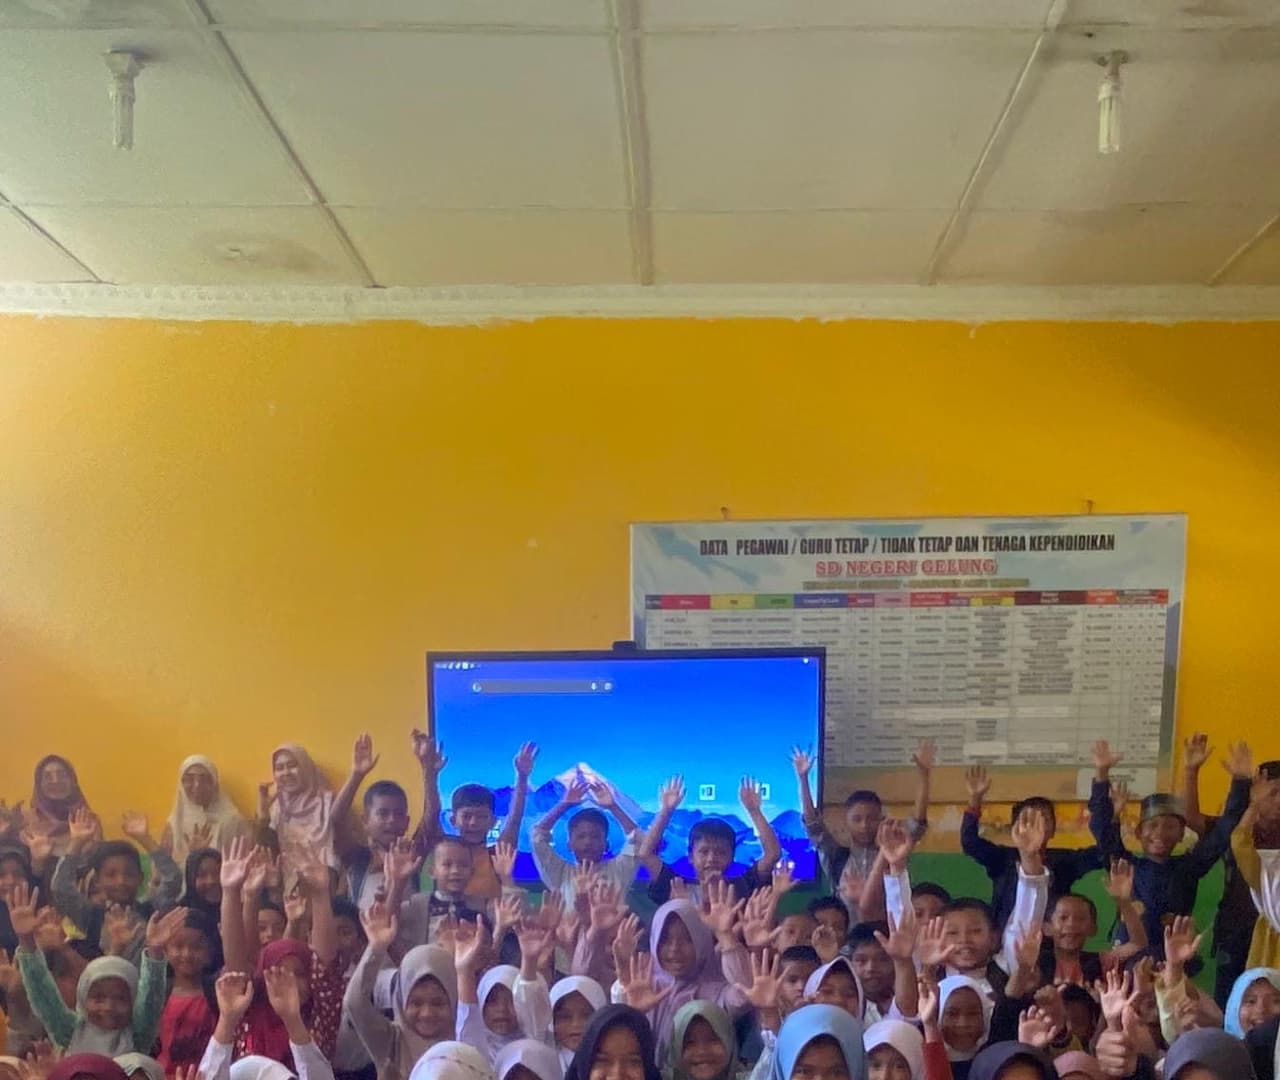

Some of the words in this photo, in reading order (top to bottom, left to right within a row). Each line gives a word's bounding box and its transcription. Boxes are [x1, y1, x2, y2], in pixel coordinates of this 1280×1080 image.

[700, 539, 728, 556] DATA
[736, 538, 789, 556] PEGAWAI
[800, 537, 832, 555] GURU
[834, 537, 869, 554] TETAP
[880, 536, 915, 554] TIDAK
[918, 535, 952, 553] TETAP
[955, 535, 979, 552] DAN
[982, 535, 1026, 552] TENAGA
[1029, 534, 1115, 551] KEPENDIDIKAN
[815, 561, 842, 577] SD
[846, 559, 918, 577] NEGERI
